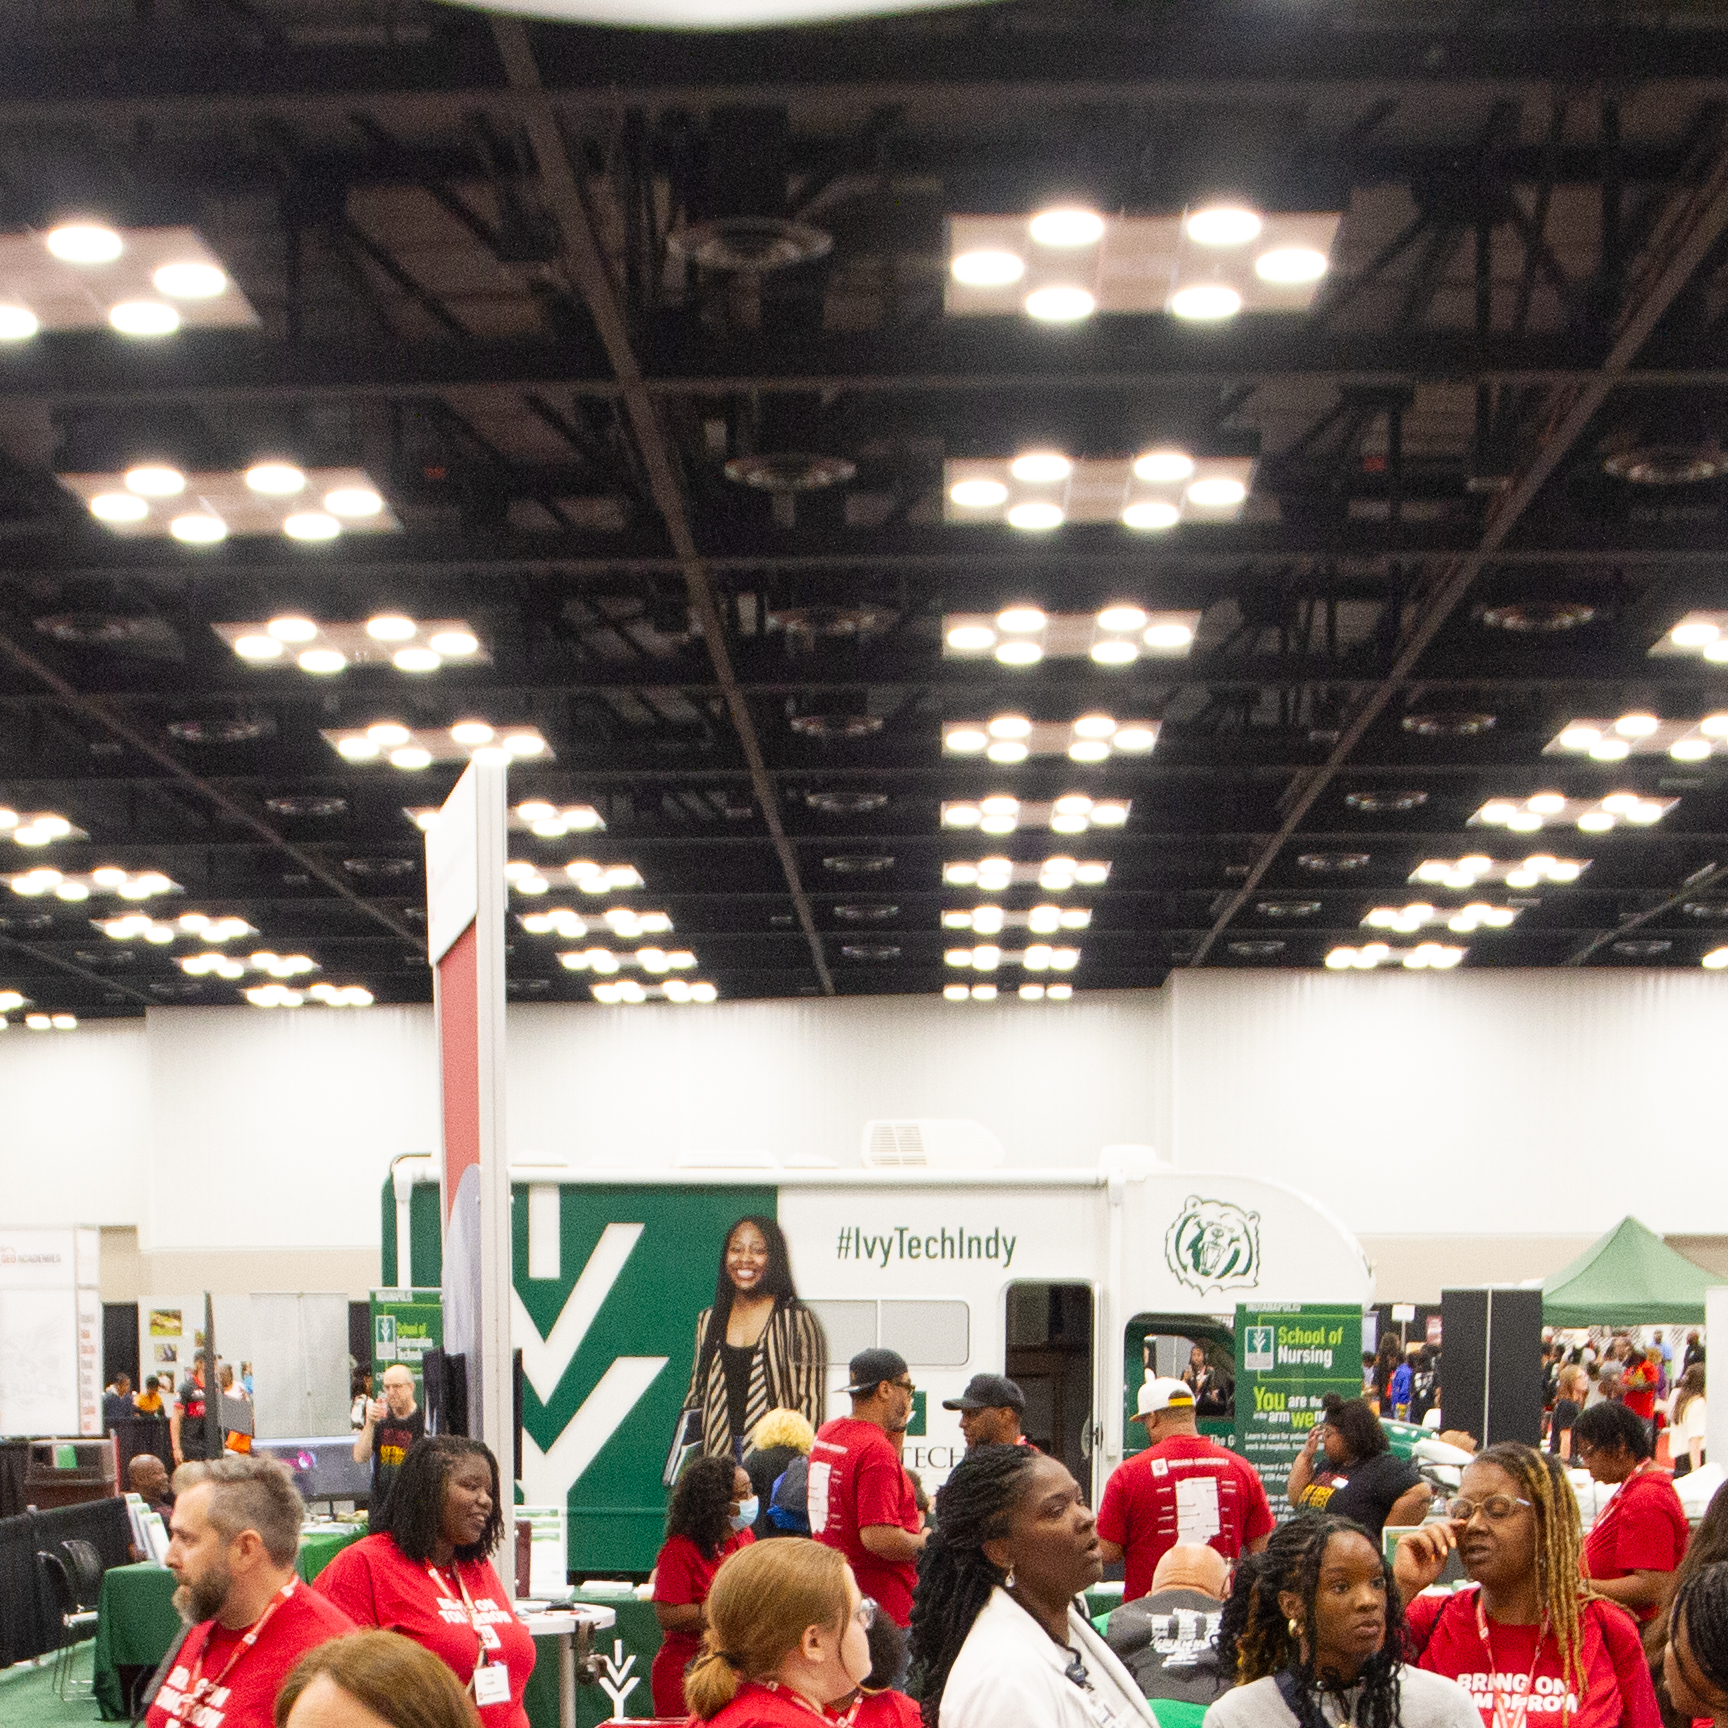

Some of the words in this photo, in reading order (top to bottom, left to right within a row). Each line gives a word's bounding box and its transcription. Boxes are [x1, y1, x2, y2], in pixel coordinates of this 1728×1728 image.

[836, 1226, 1017, 1269] #IvyTechIndy
[1278, 1326, 1326, 1346] School
[1328, 1326, 1344, 1346] of
[1277, 1345, 1334, 1369] Nursing
[1253, 1386, 1285, 1412] You
[1287, 1395, 1308, 1408] are
[1268, 1410, 1290, 1424] arm
[1290, 1410, 1315, 1429] we
[902, 1445, 968, 1469] TECH
[1457, 1672, 1531, 1692] BRING
